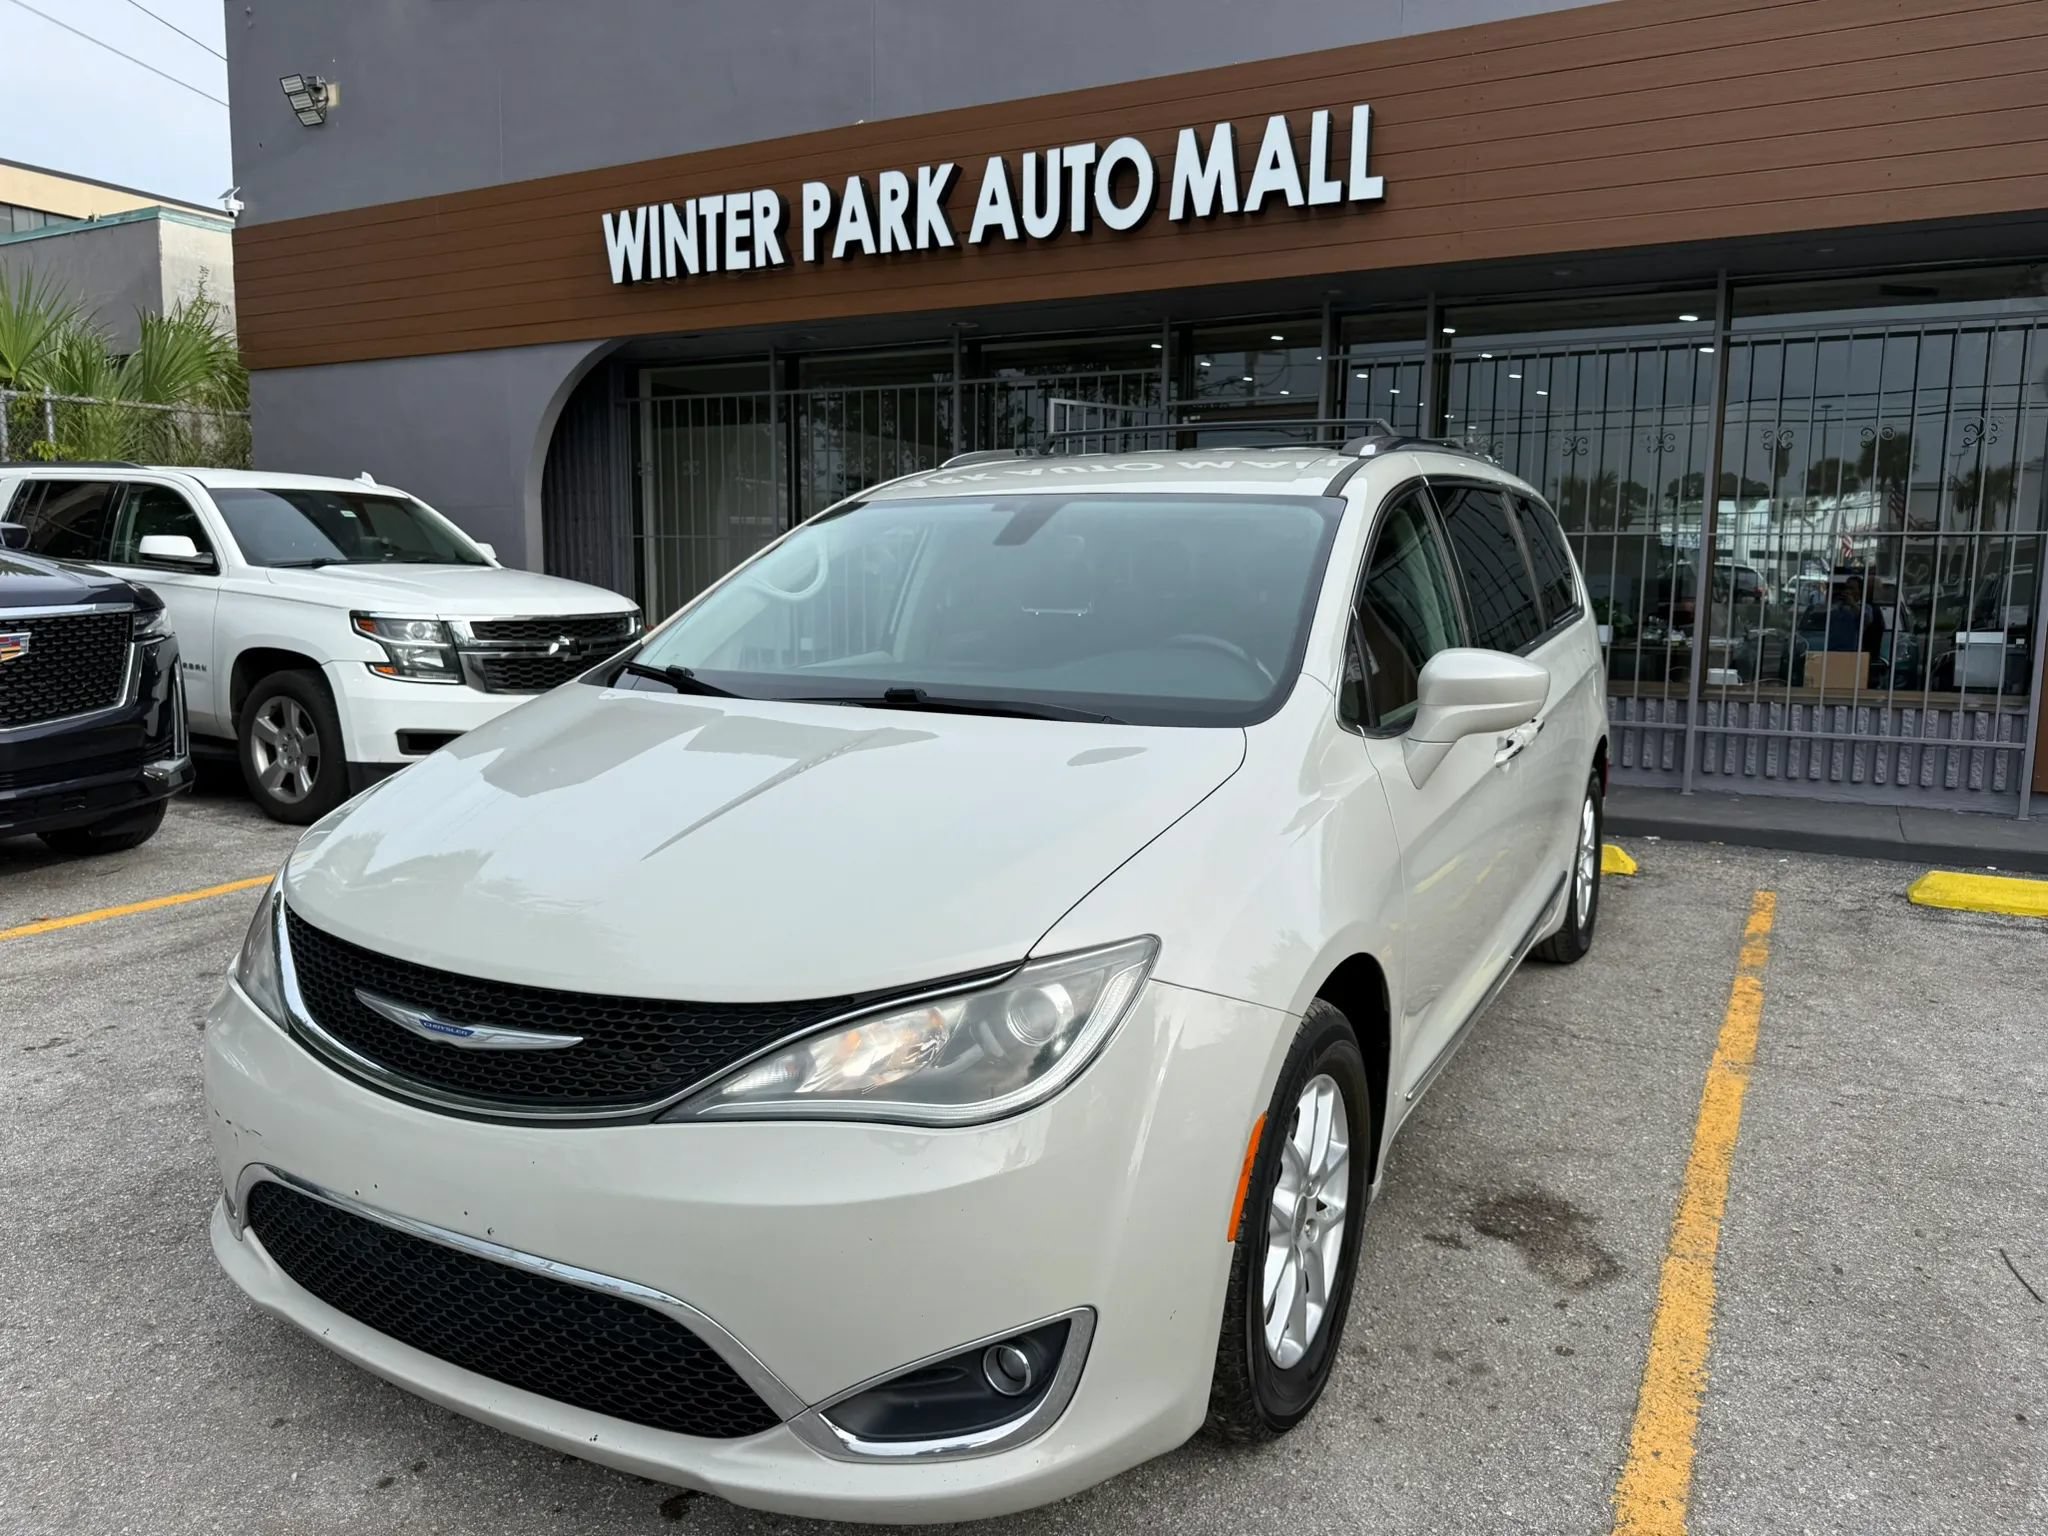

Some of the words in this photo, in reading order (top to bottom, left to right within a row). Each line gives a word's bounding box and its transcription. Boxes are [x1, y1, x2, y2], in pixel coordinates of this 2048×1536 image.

[603, 189, 784, 284] WINTER
[803, 163, 954, 262] PARK
[969, 137, 1155, 243] AUTO
[1169, 104, 1384, 221] MALL
